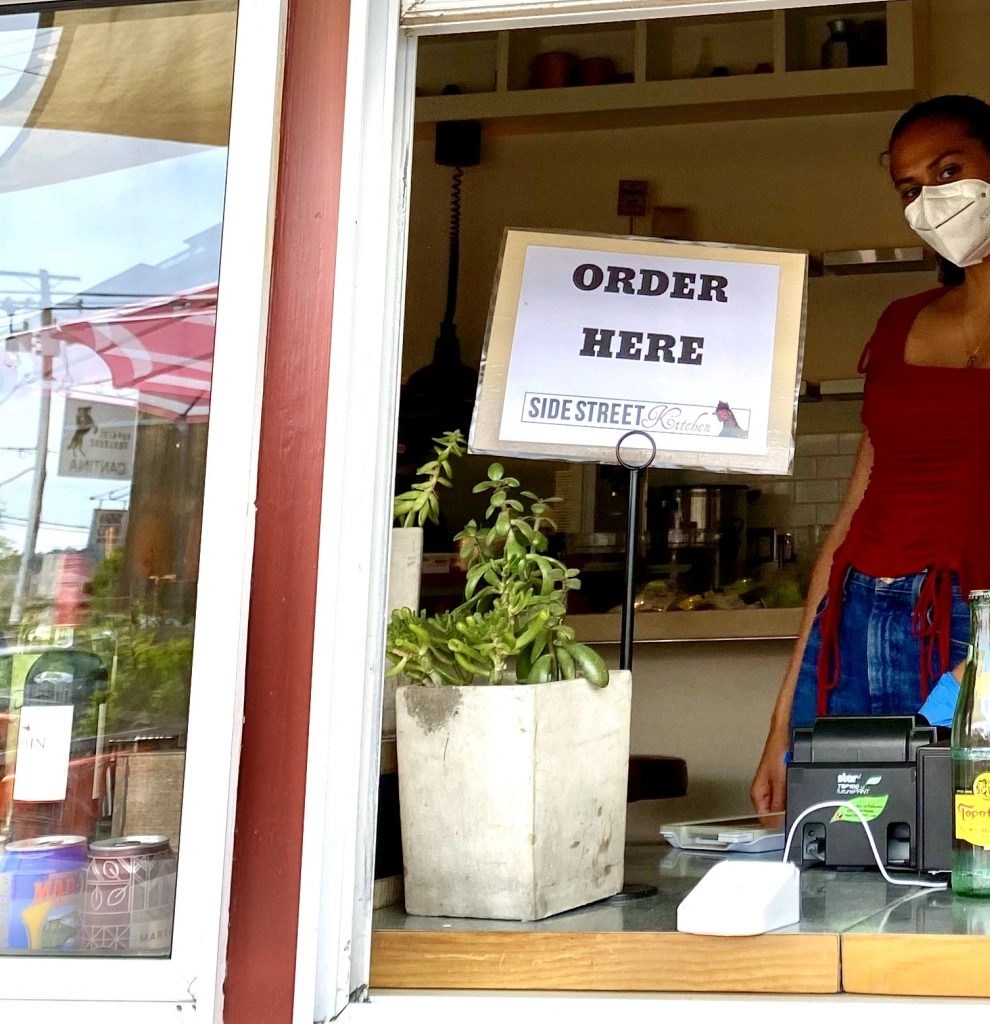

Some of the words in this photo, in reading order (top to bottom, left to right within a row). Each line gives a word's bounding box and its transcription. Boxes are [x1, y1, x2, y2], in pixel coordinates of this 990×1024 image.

[572, 263, 729, 303] ORDER
[579, 327, 705, 365] HERE
[528, 397, 573, 420] SIDE
[575, 400, 646, 426] STREET
[640, 404, 711, 433] Kitchen
[958, 803, 986, 821] Topo
